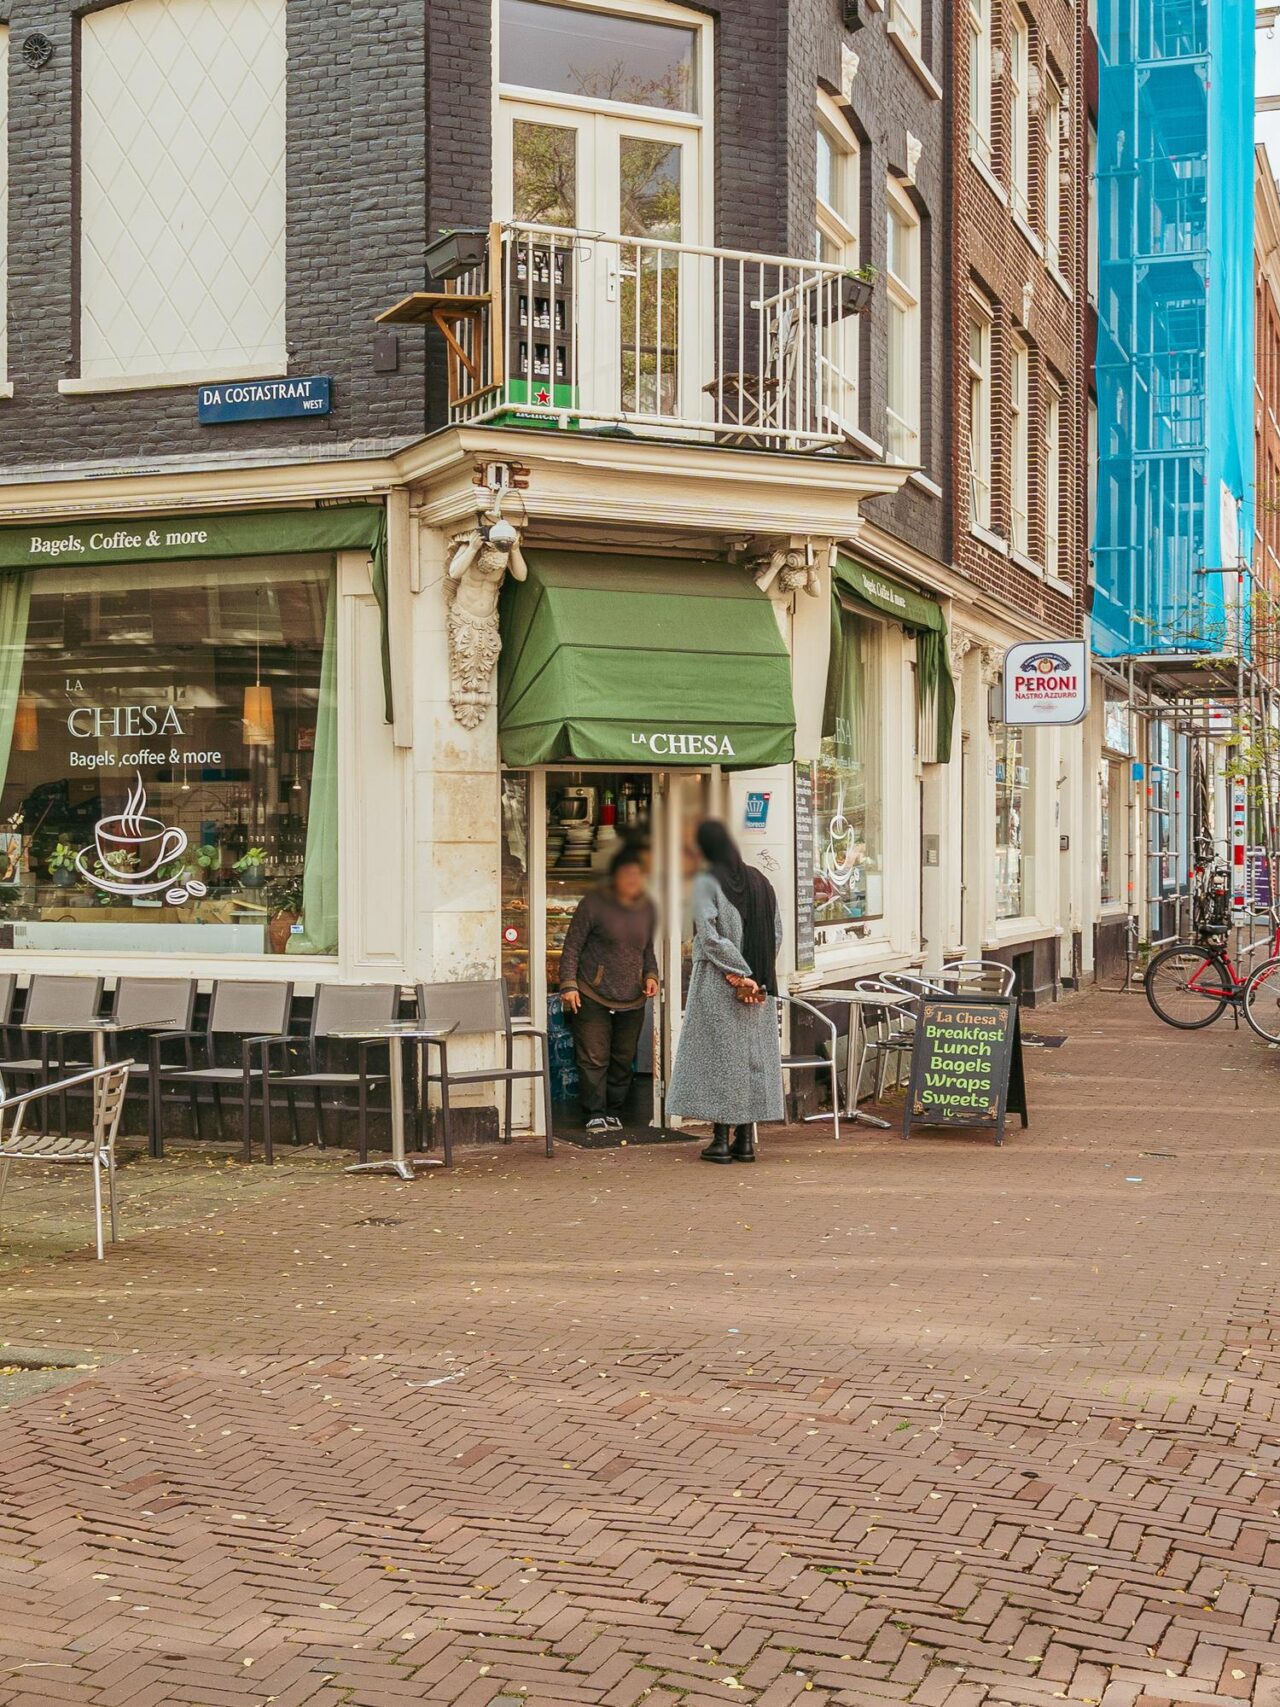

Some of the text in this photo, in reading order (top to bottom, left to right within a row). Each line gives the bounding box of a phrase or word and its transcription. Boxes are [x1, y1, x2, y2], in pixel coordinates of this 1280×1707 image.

[203, 381, 312, 405] DA COSTASTRAAT
[303, 399, 323, 409] WEST
[30, 530, 207, 556] Bagels, Coffee & more
[65, 679, 84, 691] LA
[1015, 676, 1077, 692] PERONI
[67, 705, 185, 738] CHESA
[631, 733, 736, 756] LA CHESA
[70, 751, 115, 769] Bagels
[169, 749, 180, 764] &
[183, 751, 221, 764] more
[936, 1011, 997, 1025] La Chesa
[926, 1025, 1004, 1041] Breakfast
[933, 1040, 991, 1056] Lunch
[930, 1056, 991, 1074] Bagels
[924, 1073, 991, 1093] Wraps
[921, 1090, 990, 1108] Sweets
